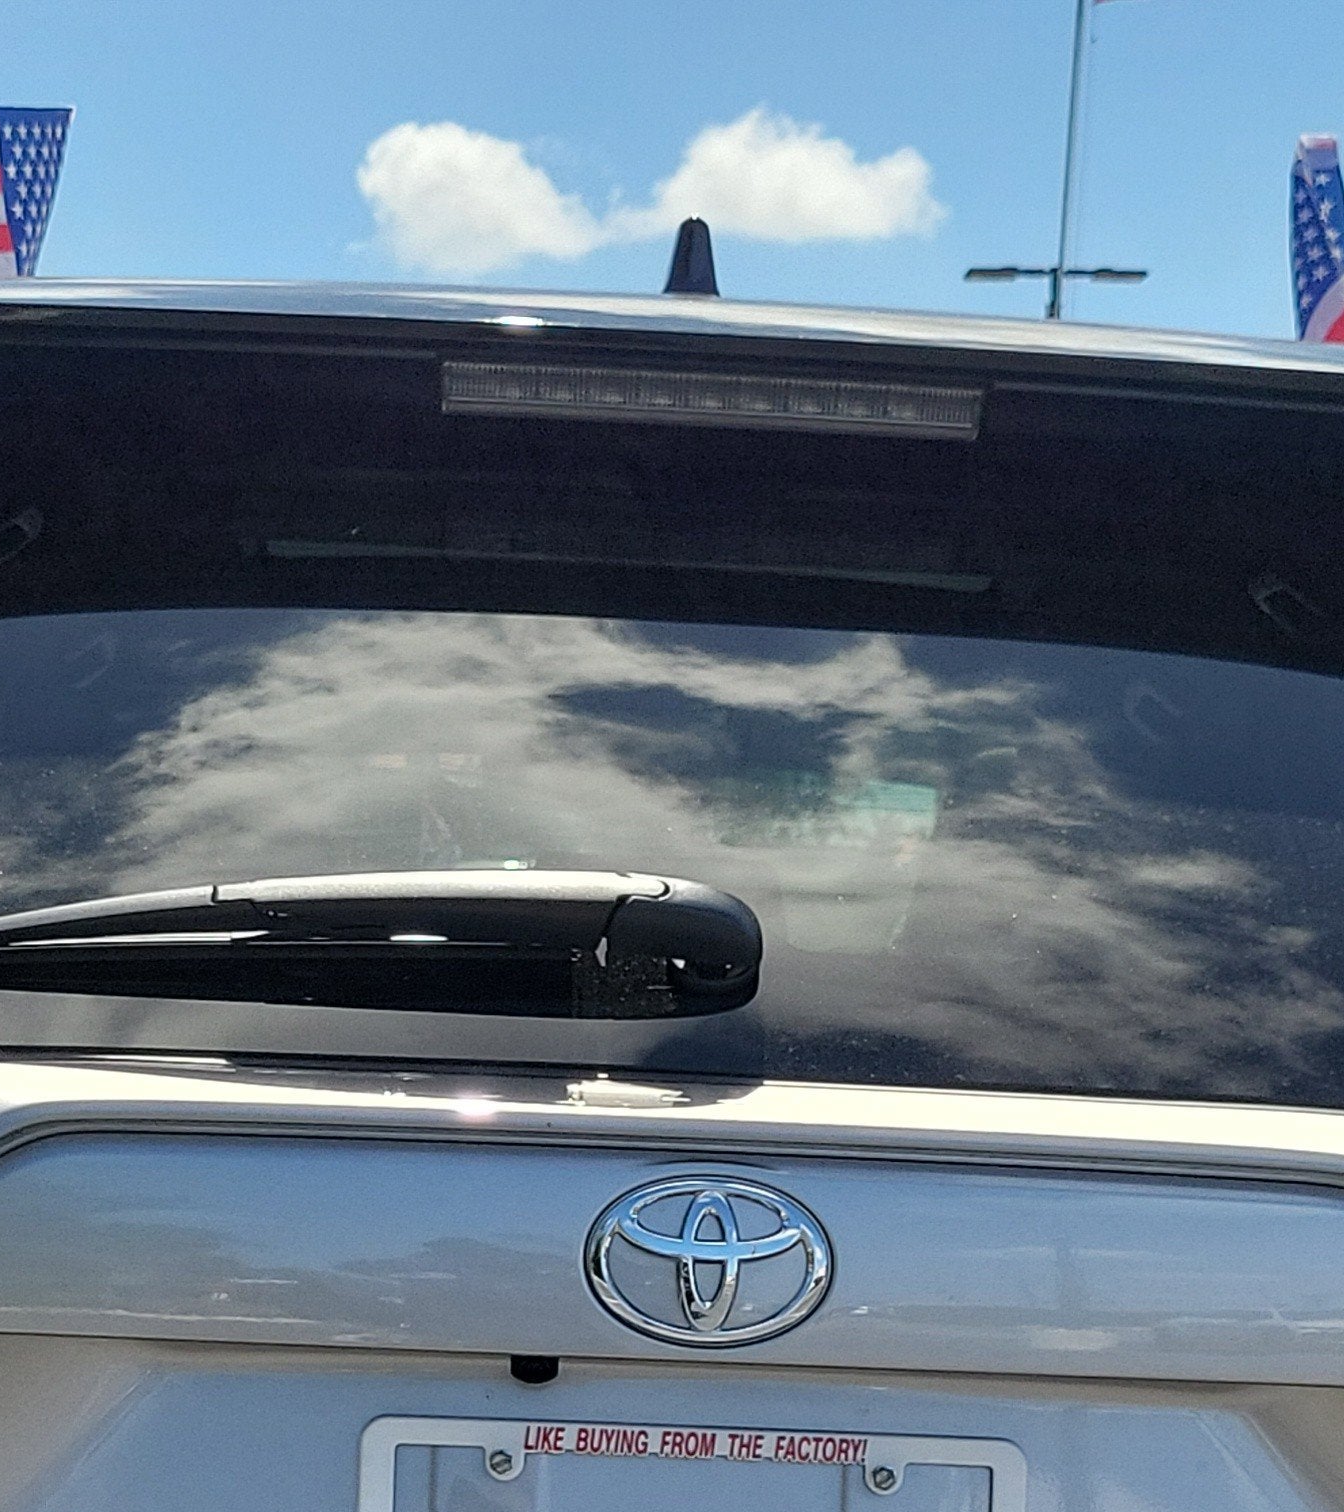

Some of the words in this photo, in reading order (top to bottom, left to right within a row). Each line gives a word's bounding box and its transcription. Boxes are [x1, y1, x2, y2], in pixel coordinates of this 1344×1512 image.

[524, 1426, 565, 1450] LIKE
[576, 1428, 649, 1454] BUYING
[660, 1431, 717, 1456] FROM
[729, 1434, 764, 1458] THE
[774, 1436, 868, 1463] FACTORY!
